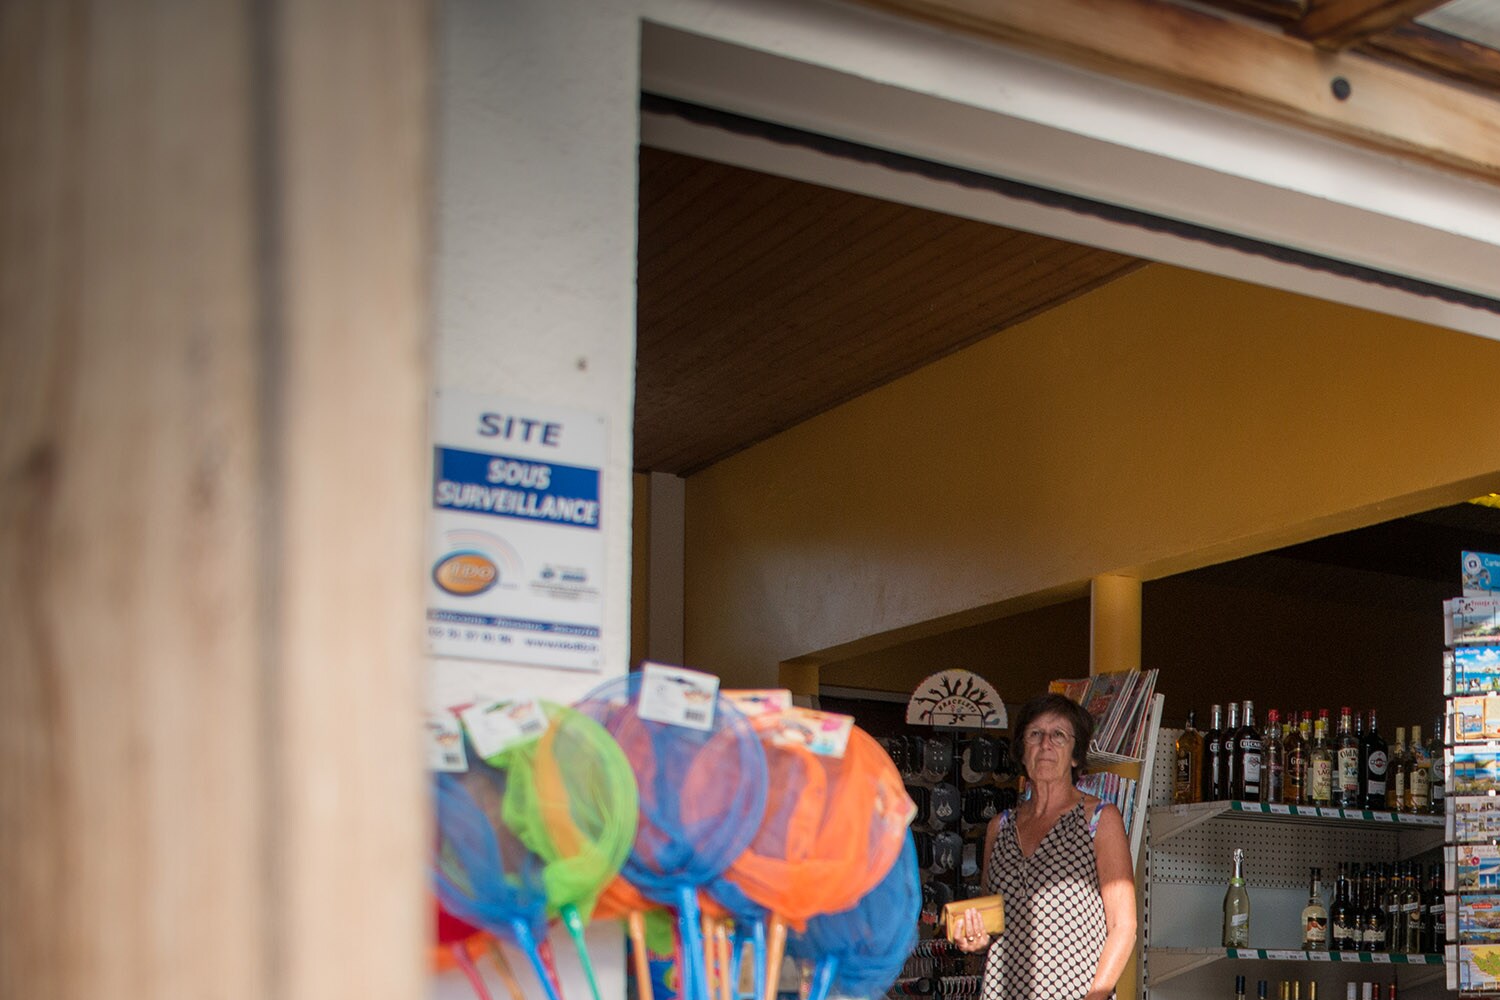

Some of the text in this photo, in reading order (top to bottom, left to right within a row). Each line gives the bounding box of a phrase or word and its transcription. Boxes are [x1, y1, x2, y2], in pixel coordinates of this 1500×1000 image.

[478, 413, 562, 446] SITE
[489, 459, 551, 490] SOUS
[436, 481, 599, 525] SURVEILLANCE
[938, 698, 977, 713] BRACELETS
